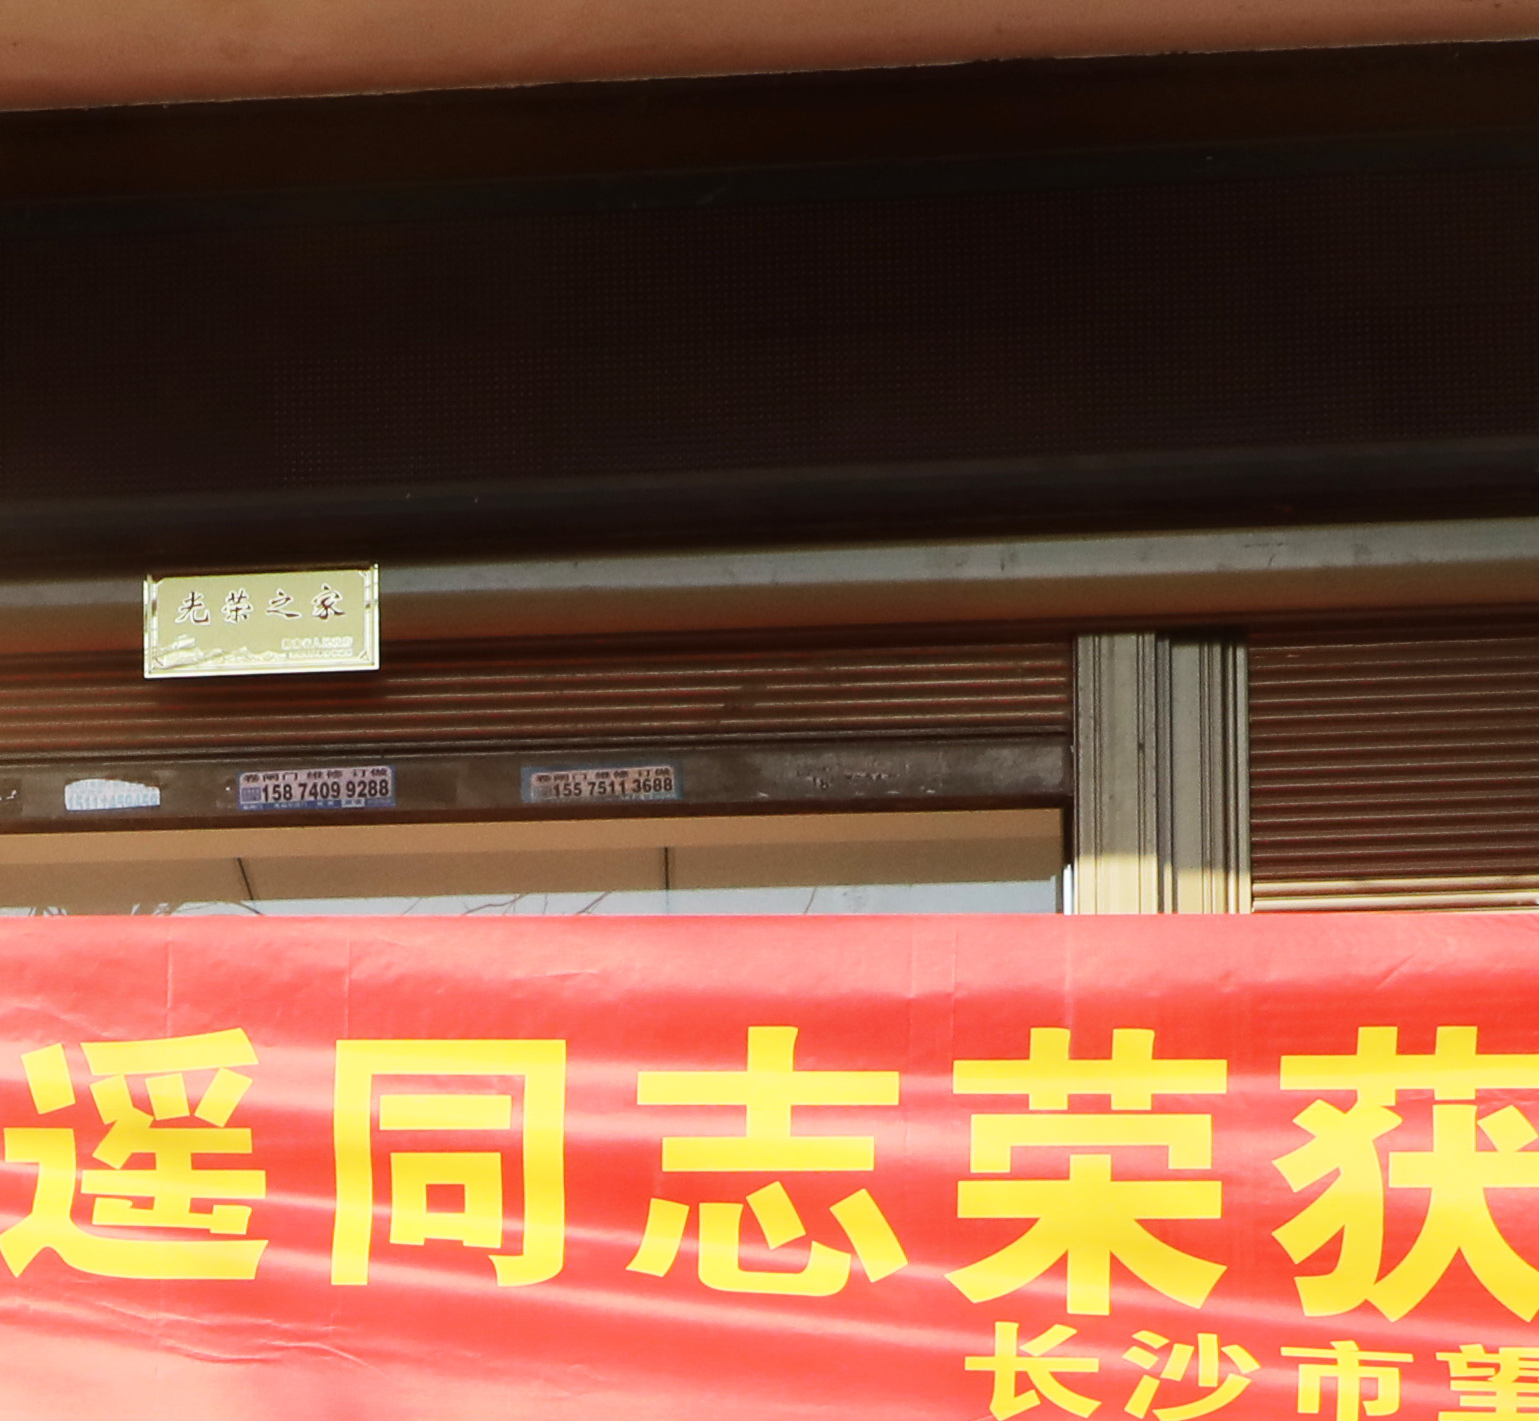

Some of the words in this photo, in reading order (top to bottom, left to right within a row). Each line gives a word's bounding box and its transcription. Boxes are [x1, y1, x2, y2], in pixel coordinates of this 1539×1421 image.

[174, 585, 346, 626] 光荣之家
[262, 783, 293, 801] 158
[298, 781, 340, 799] 7409
[346, 779, 389, 798] 9288
[553, 782, 582, 798] 155
[587, 781, 626, 795] 7511
[632, 778, 672, 793] 3688
